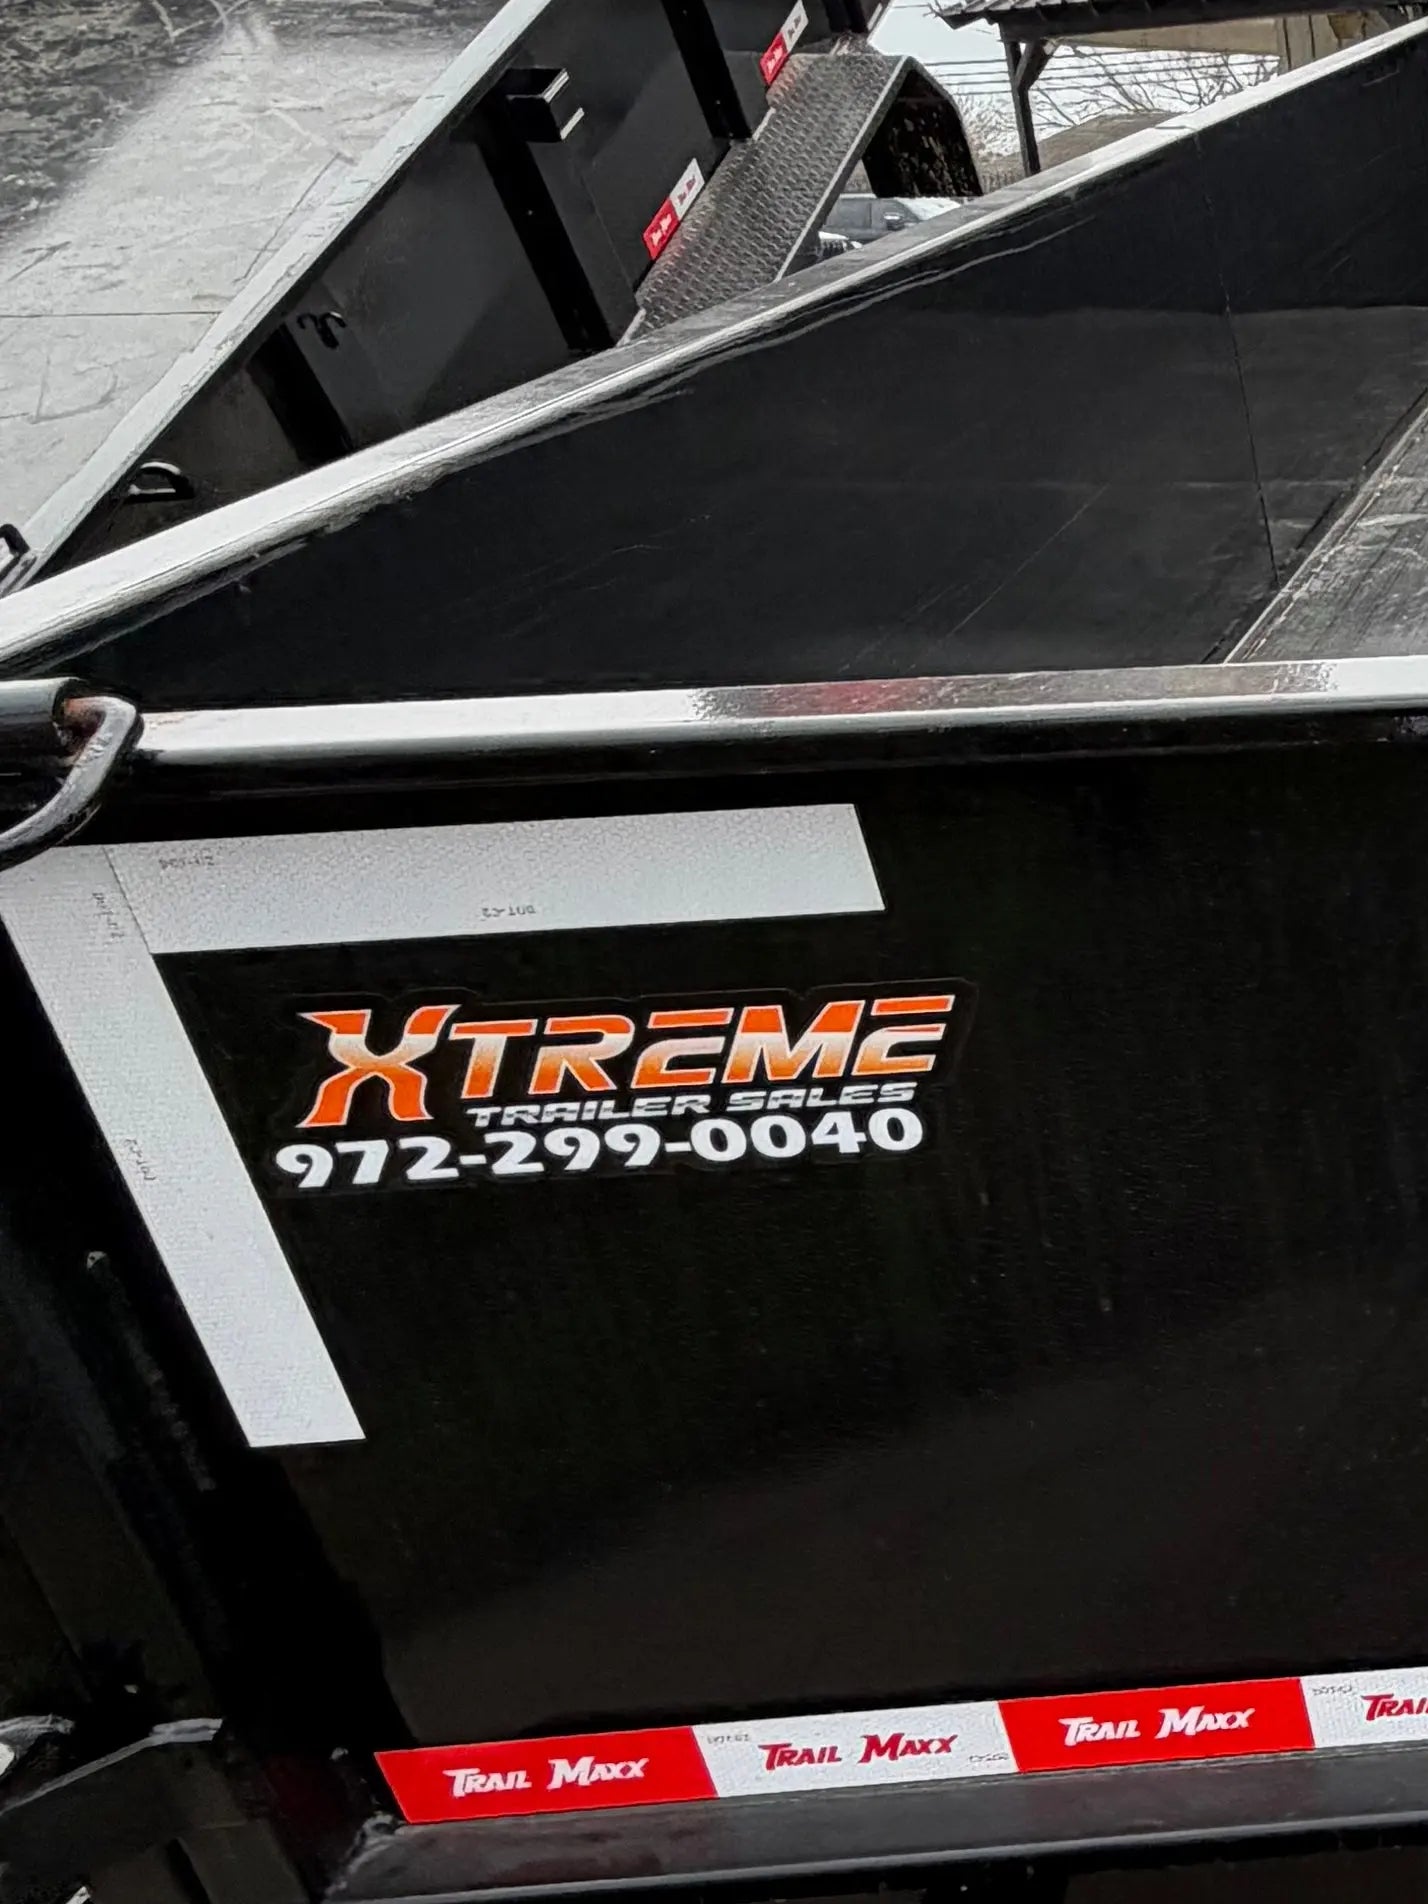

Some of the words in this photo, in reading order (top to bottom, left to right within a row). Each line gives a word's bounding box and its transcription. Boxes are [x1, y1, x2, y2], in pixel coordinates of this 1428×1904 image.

[297, 995, 955, 1128] XTREME
[467, 1093, 714, 1128] TRAILER
[725, 1081, 917, 1110] SALES
[275, 1108, 923, 1188] 972-299-0040
